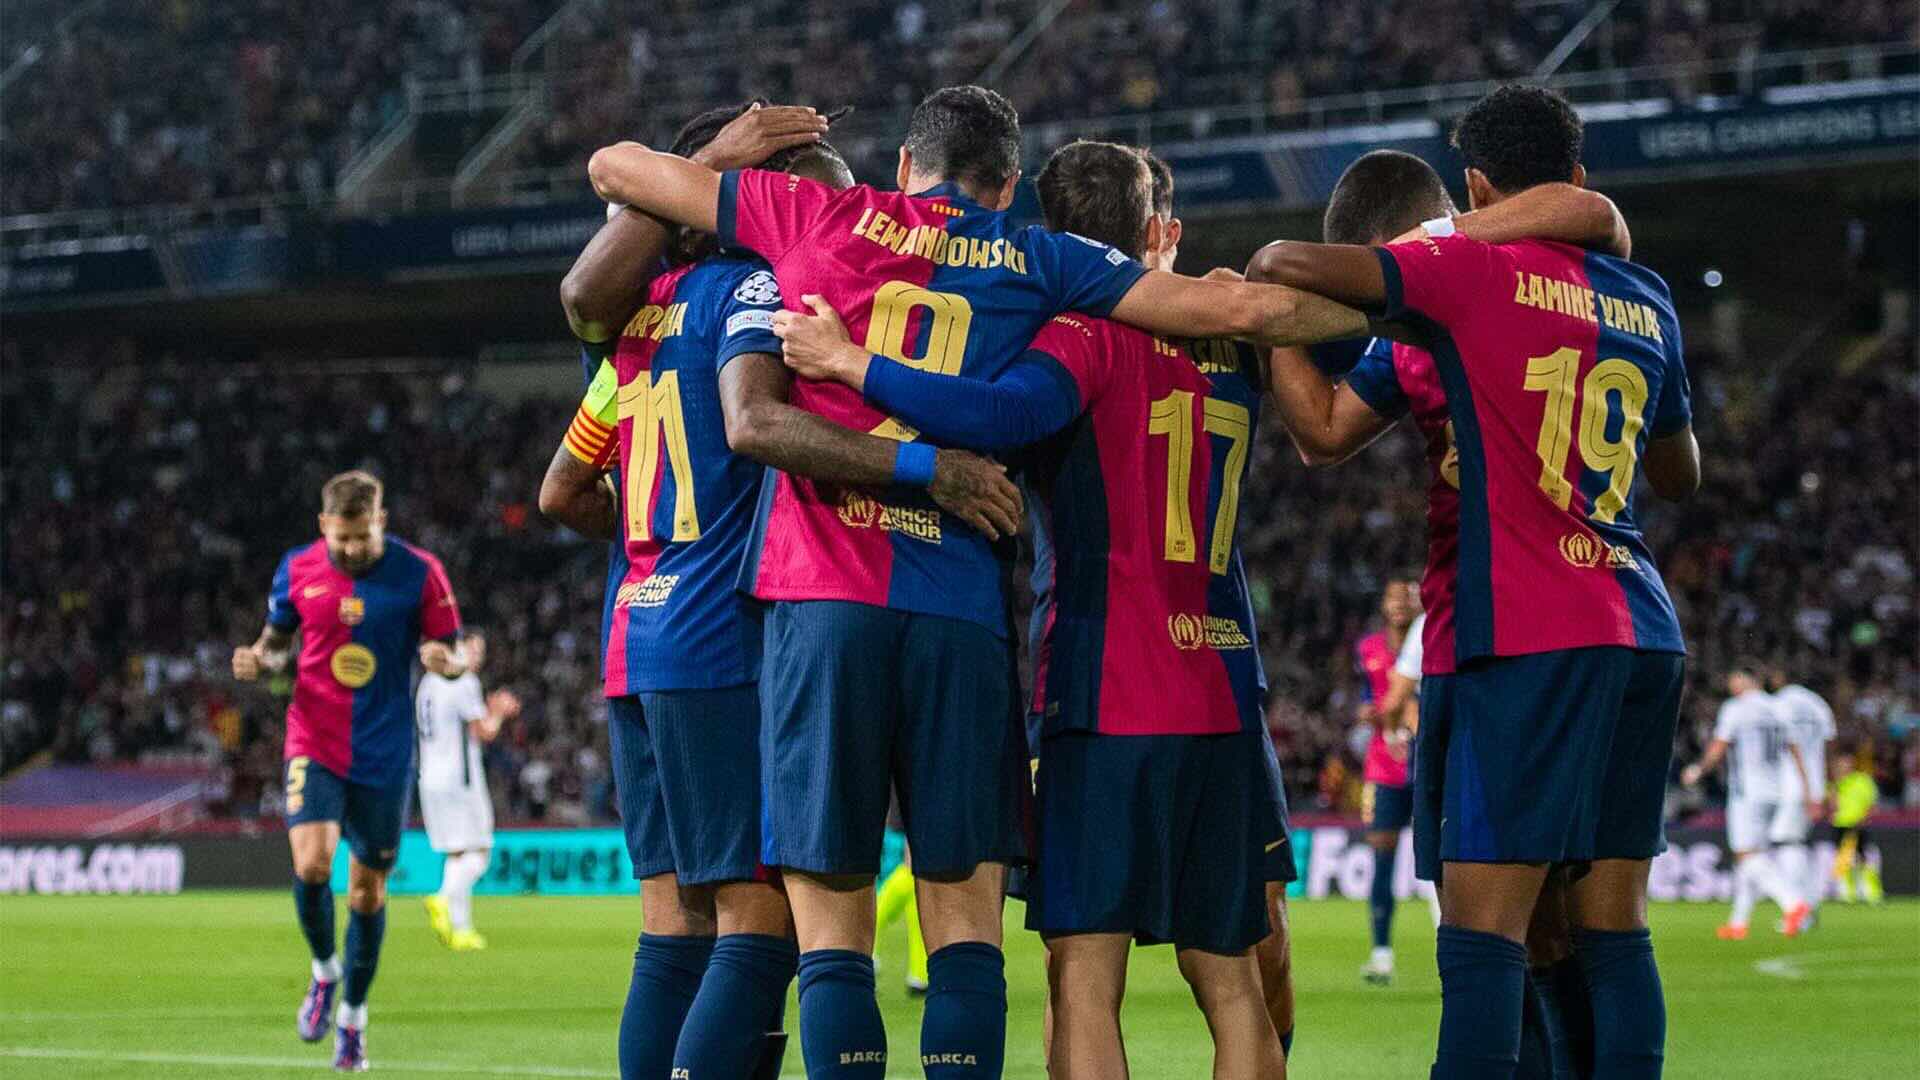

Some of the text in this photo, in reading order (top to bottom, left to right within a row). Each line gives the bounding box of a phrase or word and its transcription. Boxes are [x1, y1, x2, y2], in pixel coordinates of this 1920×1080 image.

[852, 207, 1027, 275] LEWANDOWSKI
[1514, 271, 1599, 323] LAMINE
[617, 369, 701, 542] 11
[1523, 346, 1649, 525] 19
[1148, 389, 1250, 577] 17
[1202, 614, 1241, 633] UNHCR
[286, 756, 310, 794] 5
